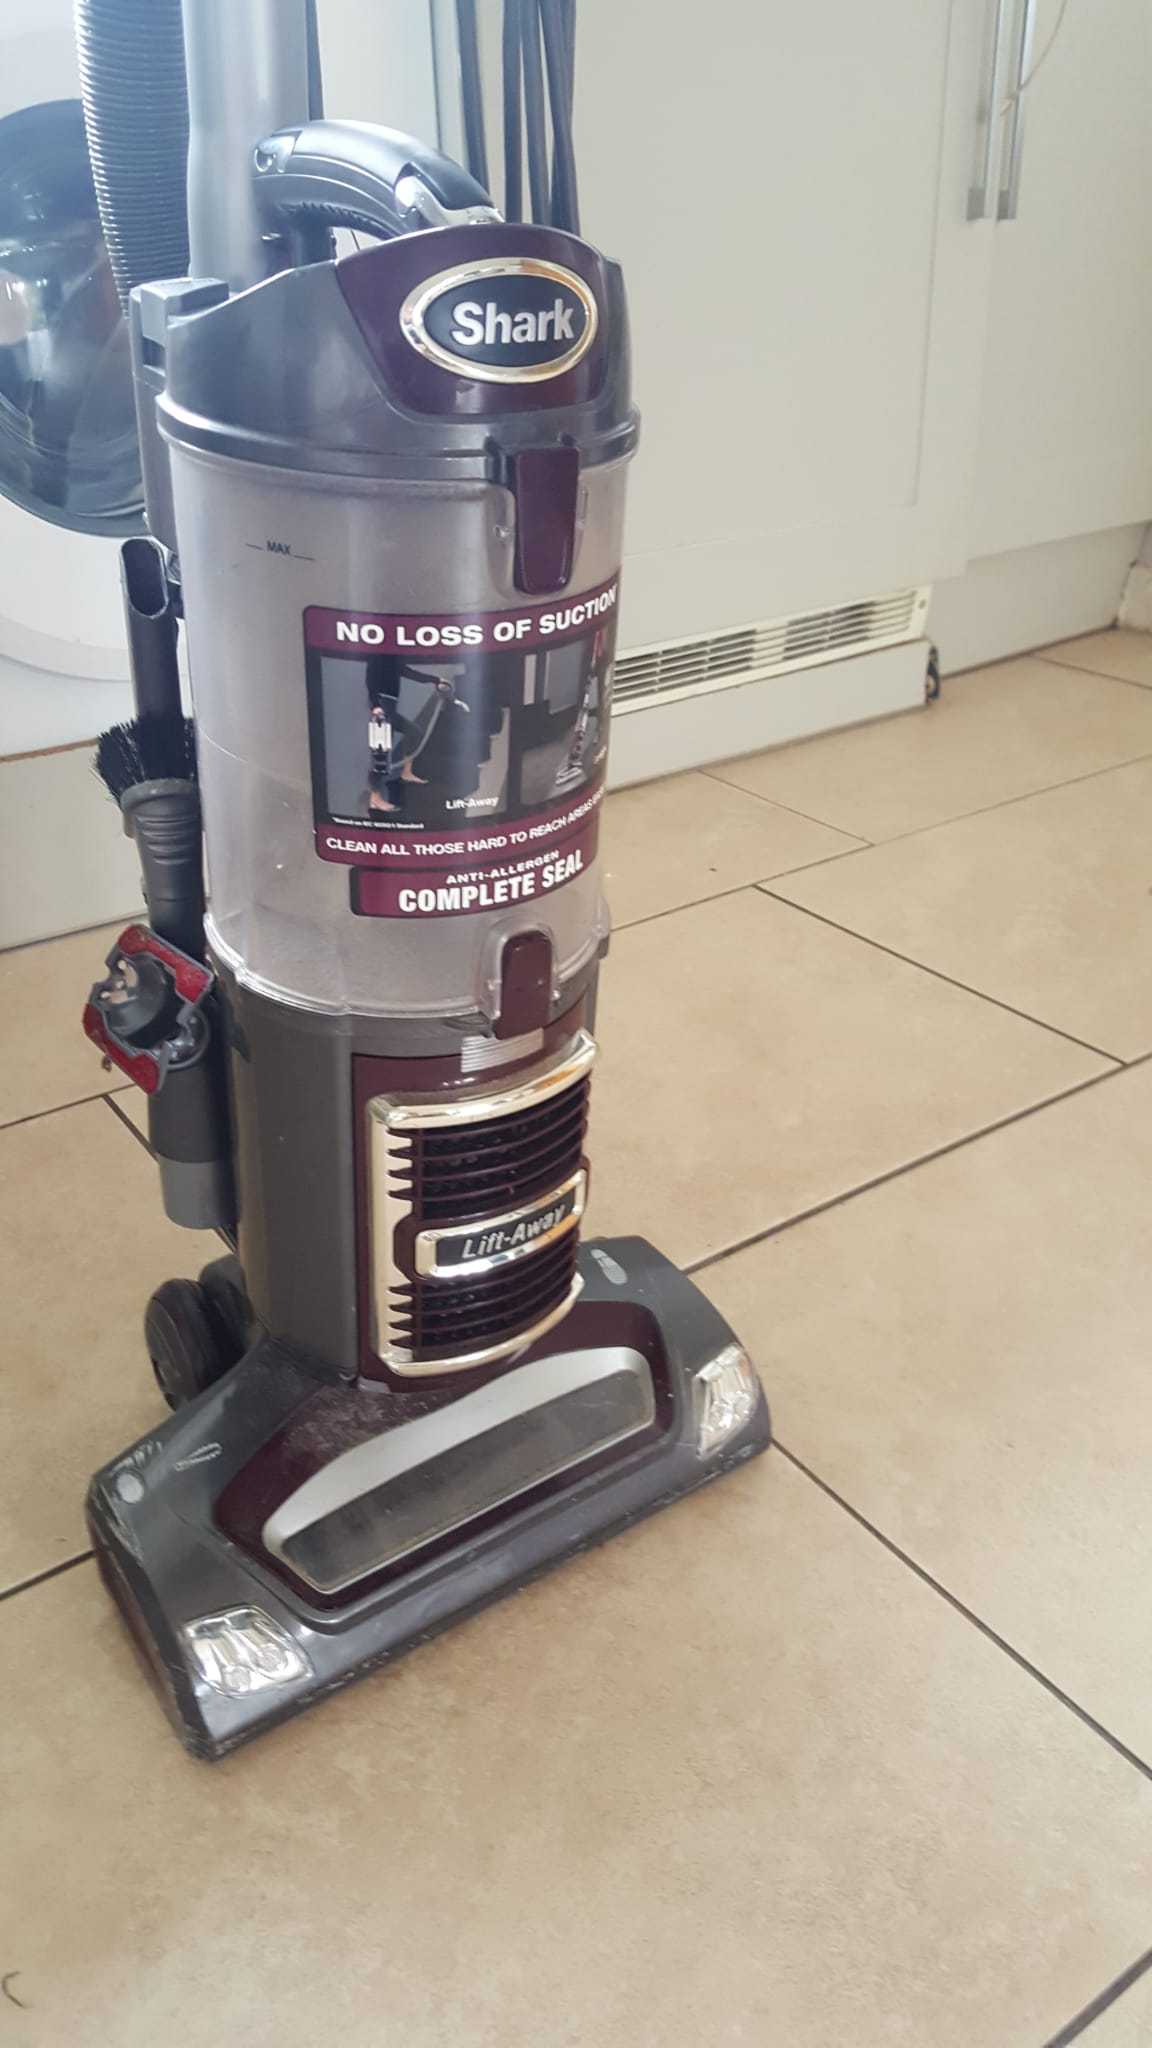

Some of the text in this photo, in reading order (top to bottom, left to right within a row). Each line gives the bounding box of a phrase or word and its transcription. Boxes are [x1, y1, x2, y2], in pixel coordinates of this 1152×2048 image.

[451, 298, 575, 346] Shark
[267, 540, 291, 555] MAX
[336, 583, 617, 647] NO LOSS OF SUCTION
[446, 797, 499, 810] Lift-Away
[325, 837, 378, 854] CLEAN
[381, 843, 411, 856] ALL
[413, 841, 464, 856] THOSE
[467, 836, 508, 851] HARD
[509, 831, 528, 845] TO
[529, 815, 567, 840] REACH
[399, 849, 584, 913] COMPLETE SEAL
[446, 850, 560, 884] ANTI-ALLERGEN
[461, 1204, 567, 1259] Lift-Away
